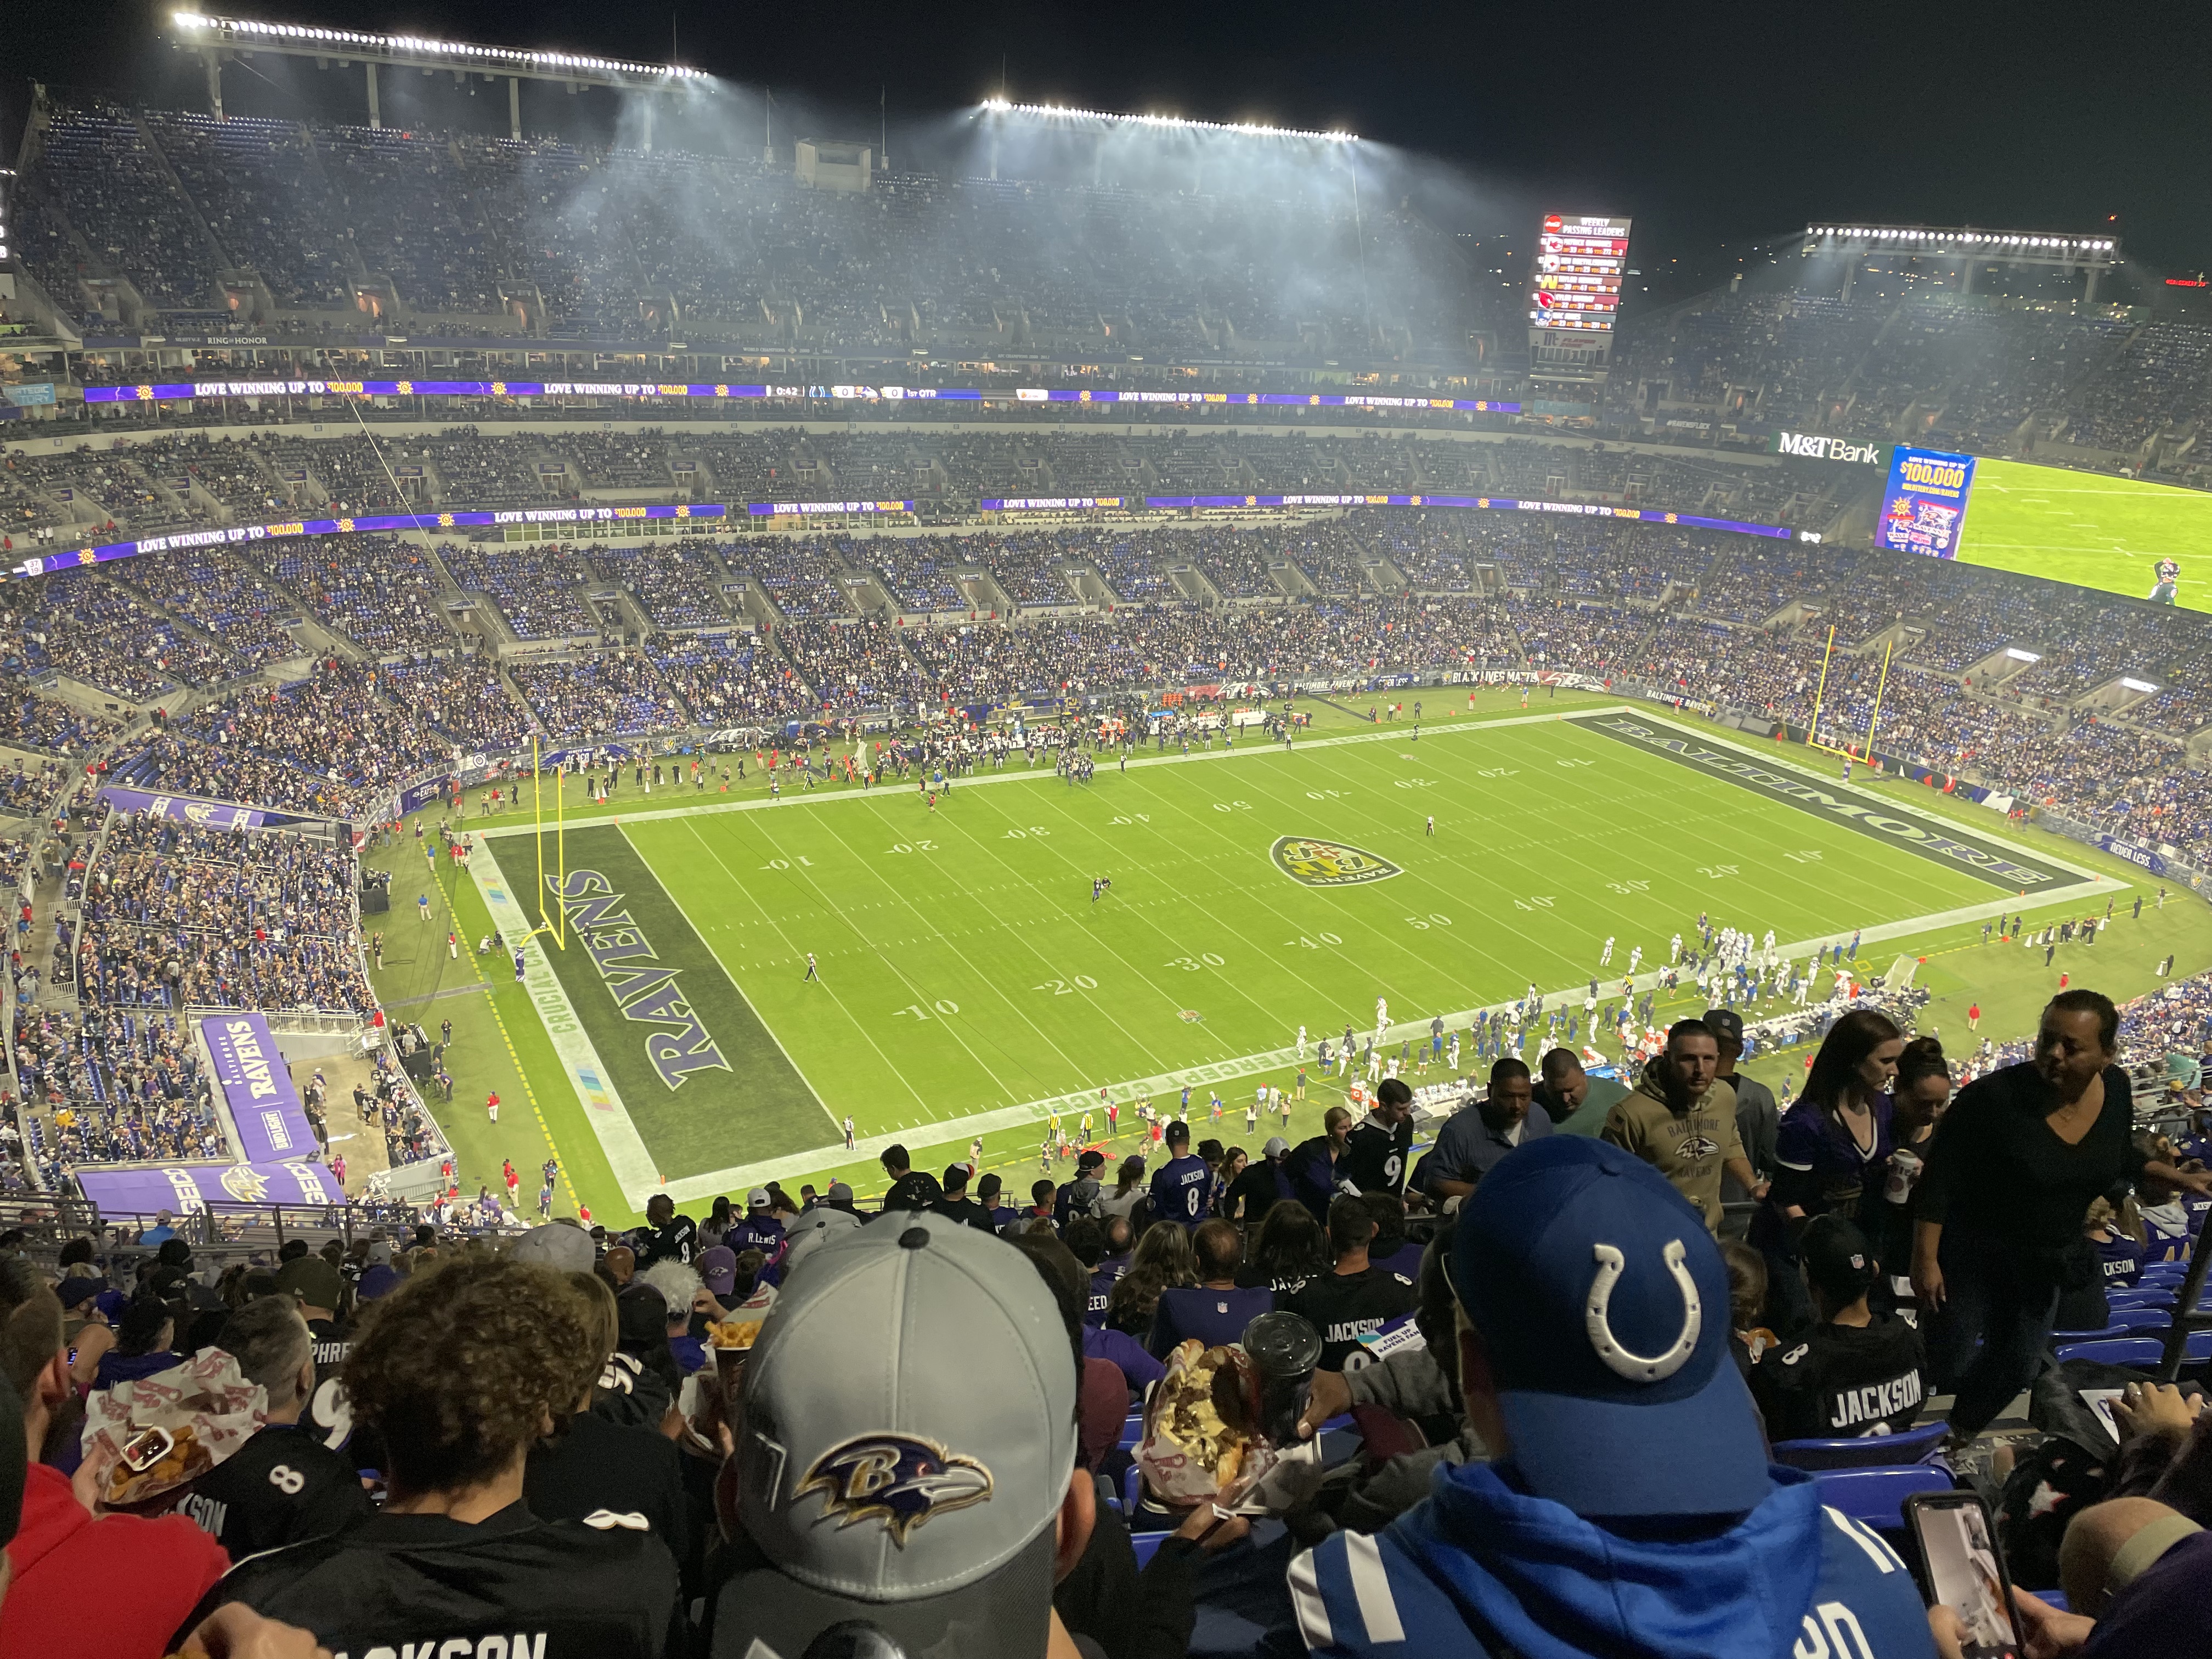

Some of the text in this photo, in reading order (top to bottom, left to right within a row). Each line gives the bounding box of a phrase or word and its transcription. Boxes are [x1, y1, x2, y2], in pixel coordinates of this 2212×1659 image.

[1563, 225, 1624, 236] PASSING LEADERS
[235, 336, 267, 345] HONOR
[195, 383, 226, 396] LOVE
[228, 382, 286, 394] WINNING
[288, 382, 306, 393] UP
[308, 382, 325, 393] TO
[544, 383, 687, 395] LOVE WINNING UP TO $100,000
[776, 387, 798, 396] 0:42
[842, 388, 848, 397] 0
[891, 389, 898, 397] 0
[1119, 392, 1139, 401] LOVE
[1140, 392, 1177, 402] WINNING
[1178, 393, 1190, 402] UP
[1190, 393, 1202, 402] TO
[1345, 396, 1364, 405] LOVE
[1366, 397, 1402, 407] WINNING
[1404, 398, 1416, 407] UP
[1417, 398, 1428, 407] TO
[1778, 432, 1880, 465] M&T Bank
[1900, 461, 1965, 488] $100,000
[773, 503, 798, 513] LOVE
[800, 502, 844, 512] WINNING
[847, 502, 860, 511] UP
[861, 501, 874, 511] TO
[1003, 498, 1025, 508] LOVE
[1026, 498, 1066, 508] WINNING
[1068, 498, 1080, 507] UP
[1081, 498, 1093, 507] TO
[1283, 495, 1302, 504] LOVE
[1304, 495, 1340, 504] WINNING
[1341, 495, 1353, 504] UP
[1353, 495, 1364, 504] TO
[495, 511, 523, 522] LOVE
[524, 509, 577, 522] WINNING
[580, 509, 595, 520] UP
[597, 508, 612, 518] TO
[1518, 500, 1541, 510] LOVE
[1542, 502, 1583, 514] WINNING
[1584, 505, 1598, 515] UP
[1599, 506, 1612, 516] TO
[137, 539, 167, 554] LOVE
[170, 532, 226, 548] WINNING
[228, 528, 245, 541] UP
[247, 527, 265, 539] TO
[1483, 670, 1505, 682] LIVES
[1294, 679, 1355, 690] BALTIMORE RAVENS
[1557, 758, 1592, 768] 10
[1477, 767, 1515, 778] 20
[1394, 778, 1433, 789] 30
[1306, 789, 1340, 800] 40
[1213, 800, 1254, 813] 50
[1594, 719, 2054, 887] BALTIMORE
[1114, 813, 1151, 826] 40
[1007, 826, 1051, 840] 30
[893, 839, 939, 854] 20
[769, 855, 815, 870] 10
[1783, 849, 1822, 864] 10
[2111, 842, 2133, 860] NEVER
[2133, 851, 2151, 868] LESS.
[1311, 867, 1392, 883] RAVENS
[1695, 864, 1739, 879] 20
[1606, 879, 1650, 895] 30
[1514, 895, 1555, 912] 40
[1404, 913, 1452, 930] 50
[1296, 932, 1344, 950] 40
[1175, 952, 1226, 972] 30
[544, 869, 734, 1092] RAVENS
[1046, 974, 1098, 995] 20
[528, 971, 577, 1034] CRUCIAL
[906, 1000, 960, 1022] 10
[218, 1036, 242, 1085] BALTIMORE
[226, 1021, 277, 1099] RAVENS
[1167, 1043, 1325, 1086] INTERCEPT
[1028, 1081, 1155, 1118] CANCER
[264, 1113, 289, 1149] BUD LIGHT
[1667, 1119, 1720, 1138] BALTIMORE
[1181, 1169, 1205, 1185] JACKSON
[1384, 1155, 1402, 1186] 9
[162, 1167, 206, 1216] GEICO
[283, 1162, 329, 1205] GEICO
[1187, 1186, 1200, 1217] 8
[1051, 1219, 1060, 1229] 8
[748, 1232, 776, 1245] R.LEWIS
[681, 1242, 690, 1263] 8
[2103, 1259, 2136, 1277] CKSON
[1393, 1272, 1413, 1285] 8
[1290, 1280, 1307, 1294] 8
[1087, 1294, 1108, 1312] EED
[1325, 1317, 1385, 1342] JACKSON
[1383, 1328, 1413, 1345] FUEL UP
[1378, 1336, 1406, 1353] RAVENS
[1782, 1342, 1809, 1365] 8
[1831, 1368, 1921, 1428] JACKSON
[312, 1376, 357, 1452] 9
[270, 1464, 305, 1494] 8
[176, 1492, 228, 1537] KSON
